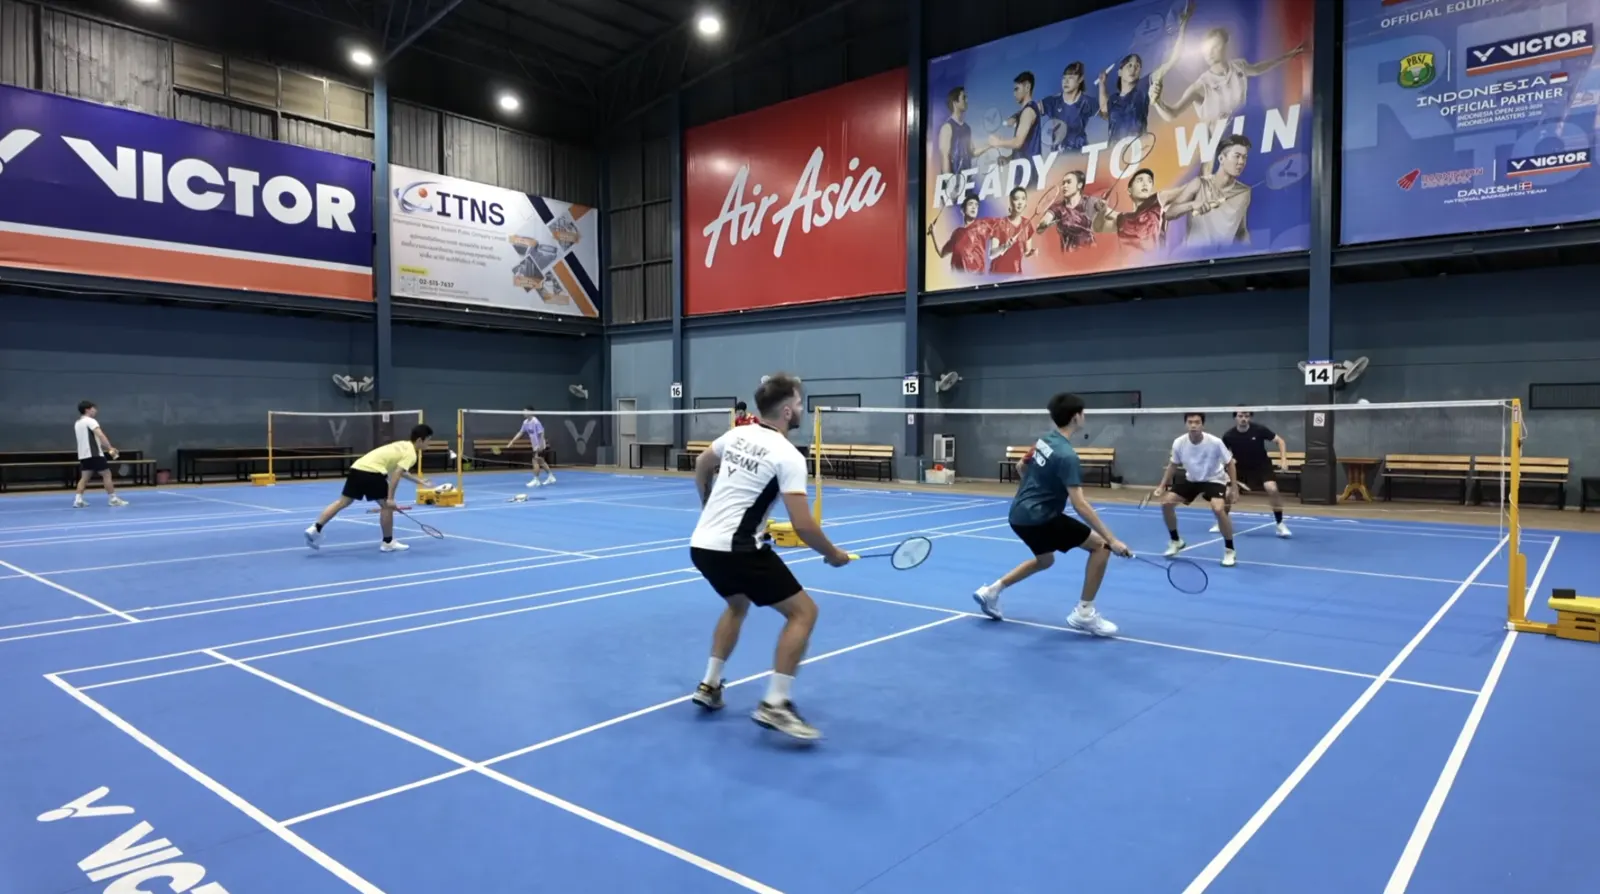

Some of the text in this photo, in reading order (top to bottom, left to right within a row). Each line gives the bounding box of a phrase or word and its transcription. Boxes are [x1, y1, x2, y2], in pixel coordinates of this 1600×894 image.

[1381, 7, 1442, 28] OFFICIAL
[1501, 29, 1587, 57] VICTOR
[1407, 54, 1426, 67] PBSI
[1416, 76, 1547, 108] INDONESIA
[1440, 99, 1497, 117] OFFICIAL
[1500, 87, 1563, 107] PARTNER
[1494, 107, 1514, 115] OPEN
[1494, 112, 1525, 121] MASTERS
[1530, 152, 1587, 167] VICTOR
[933, 151, 1059, 209] READY
[1081, 135, 1145, 184] TO
[61, 134, 357, 233] VICTOR
[1457, 184, 1517, 197] DANISH
[436, 191, 505, 226] ITNS
[1309, 368, 1330, 382] 14
[672, 387, 681, 396] 16
[905, 382, 916, 393] 15
[77, 820, 230, 894] VIC
